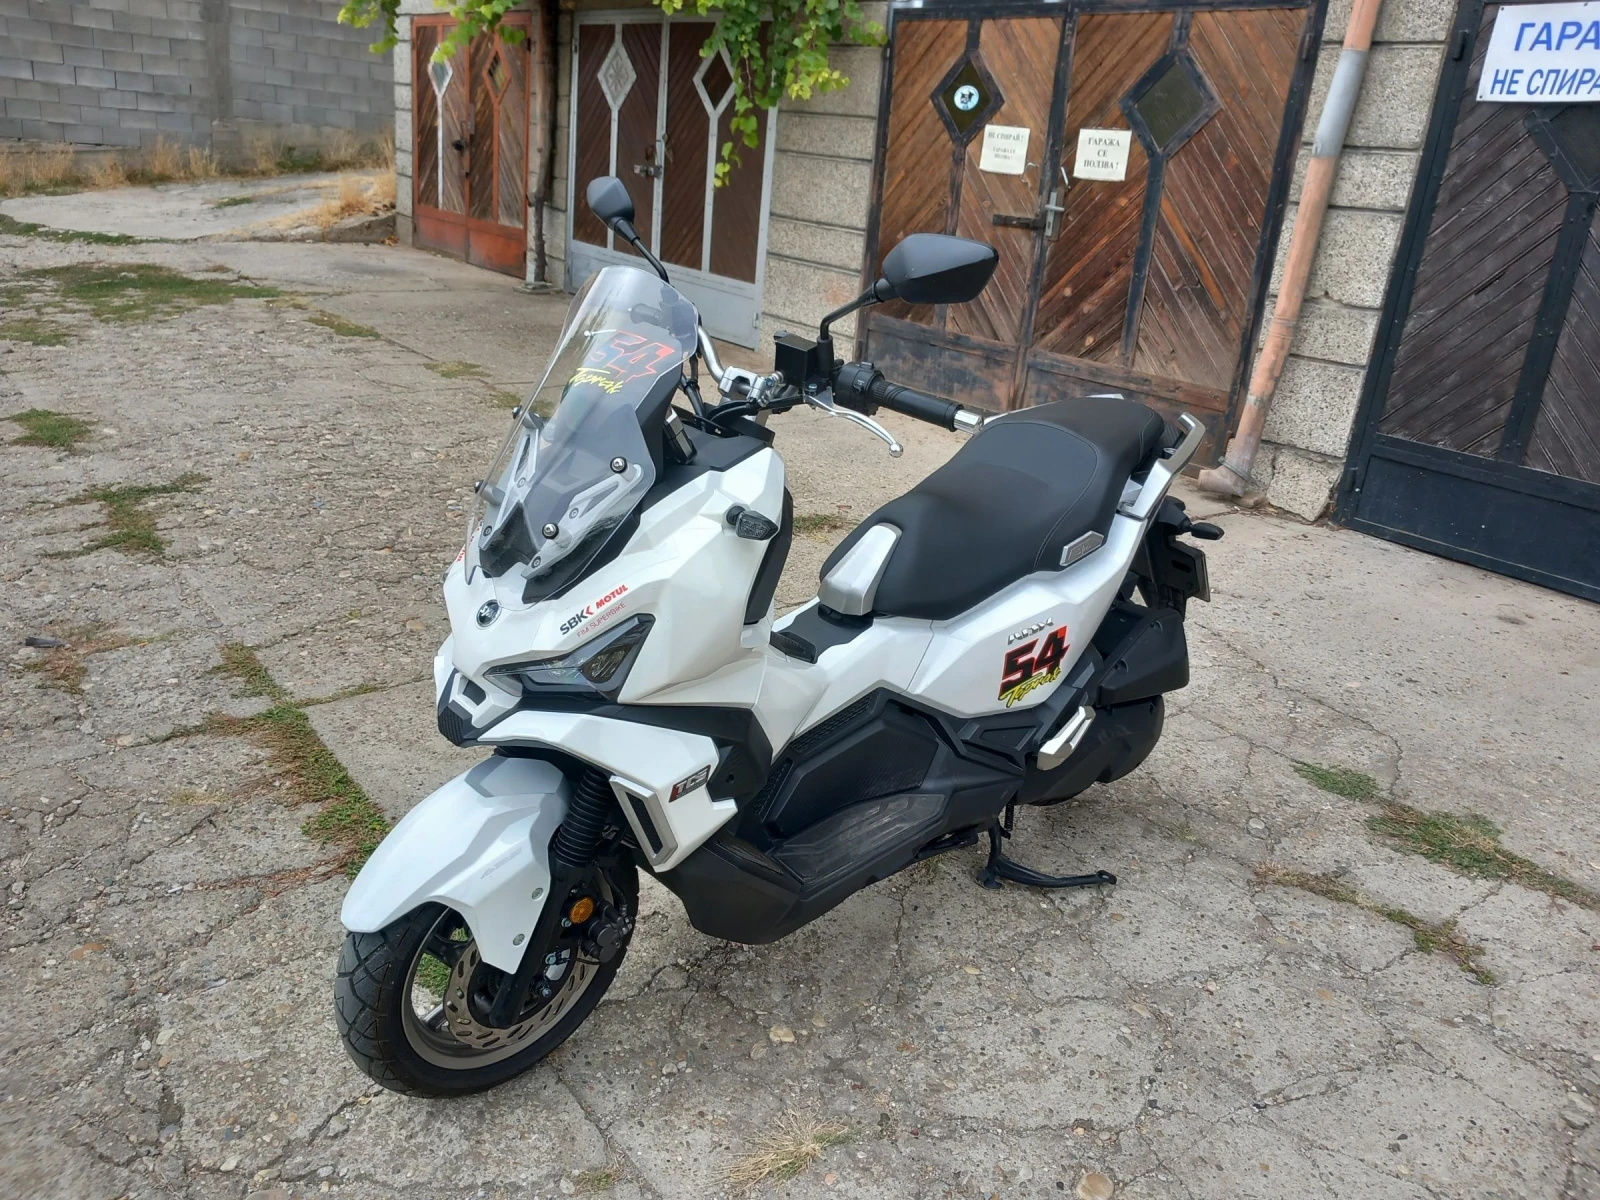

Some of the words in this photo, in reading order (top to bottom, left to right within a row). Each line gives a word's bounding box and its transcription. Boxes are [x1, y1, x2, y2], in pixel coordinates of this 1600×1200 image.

[1490, 69, 1524, 95] НЕ
[1088, 137, 1120, 147] ГАРАЖА
[1097, 148, 1108, 157] СЕ
[595, 584, 629, 610] MOTUL
[576, 627, 590, 638] FIM
[589, 601, 627, 630] SUPERBIKE
[999, 625, 1070, 698] 54
